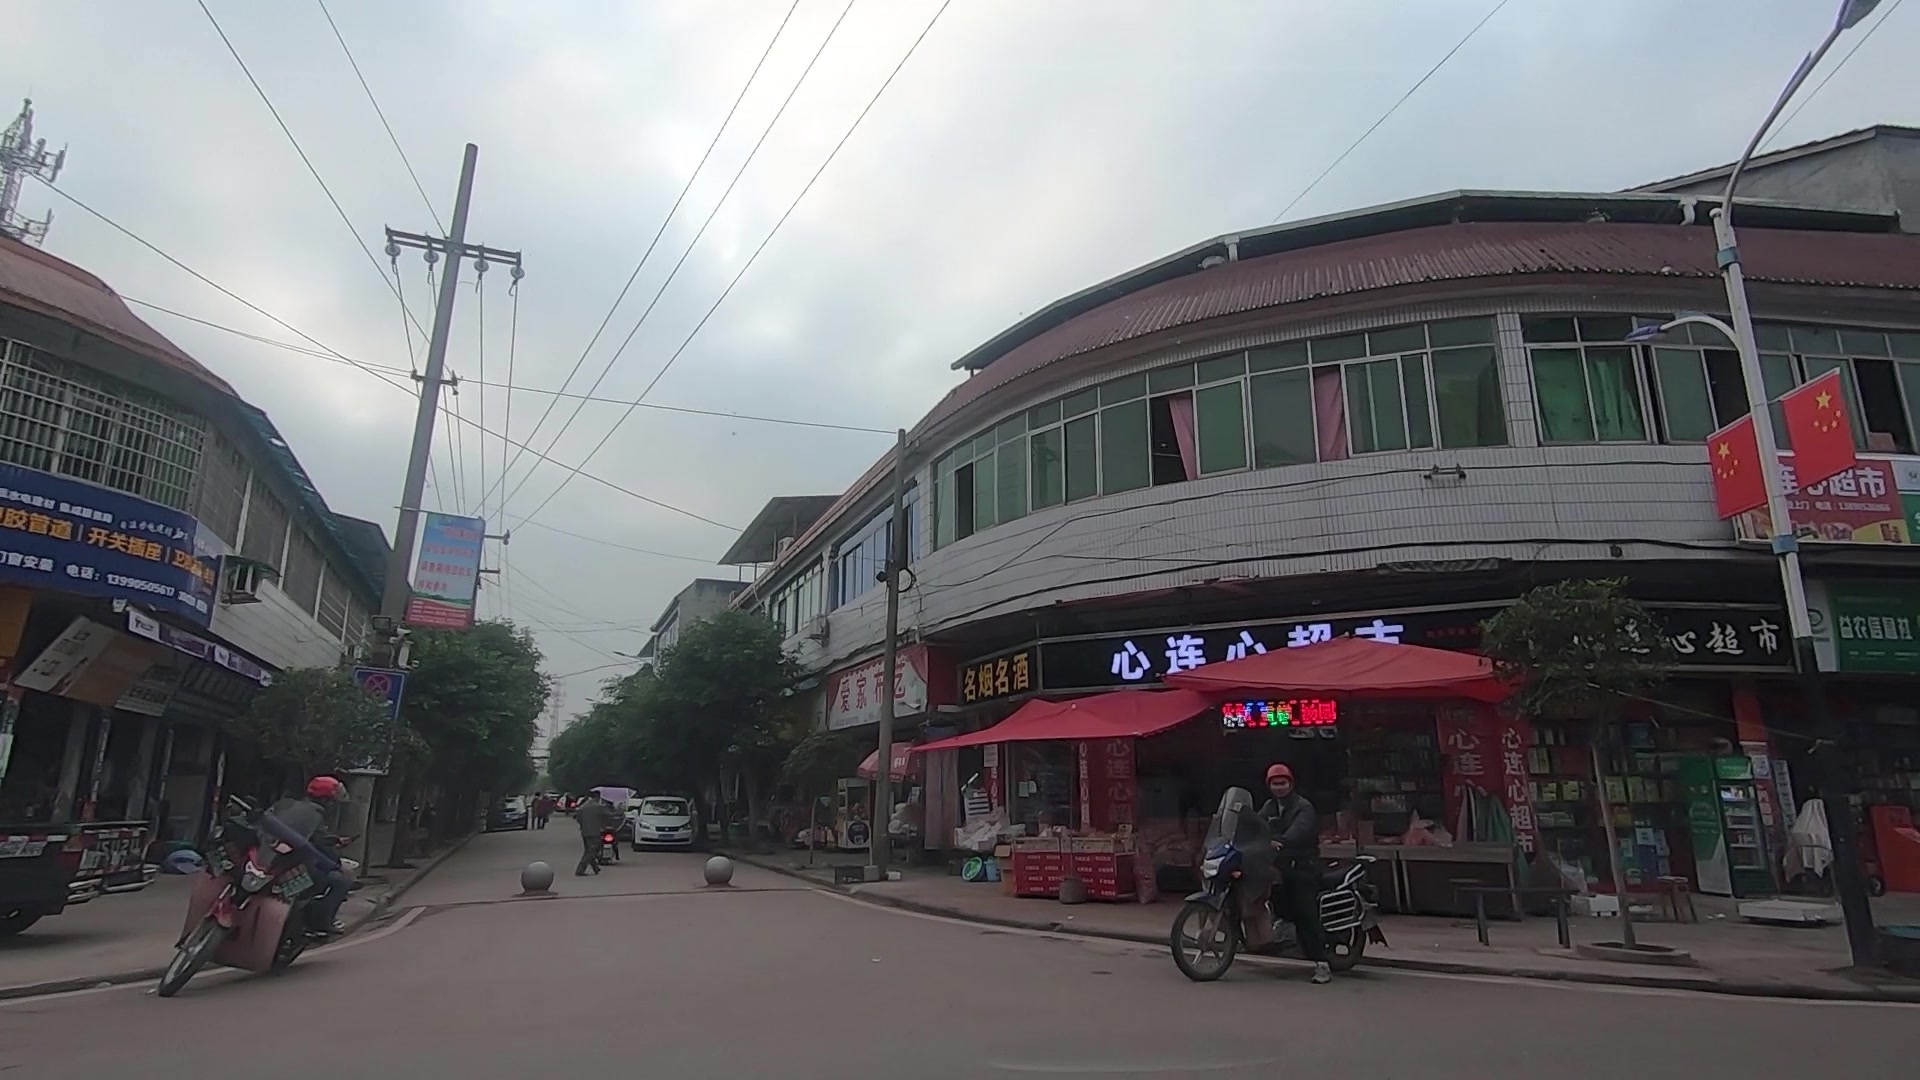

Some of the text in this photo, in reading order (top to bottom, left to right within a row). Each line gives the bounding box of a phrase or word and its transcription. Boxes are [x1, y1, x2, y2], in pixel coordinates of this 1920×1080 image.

[0, 506, 72, 540] 胶管道
[88, 526, 163, 562] 开关插座
[1571, 617, 1780, 656] 连心超市
[1838, 615, 1914, 641] 益农信息社
[963, 651, 1030, 703] 名烟名酒
[1501, 727, 1535, 853] 心连心超市
